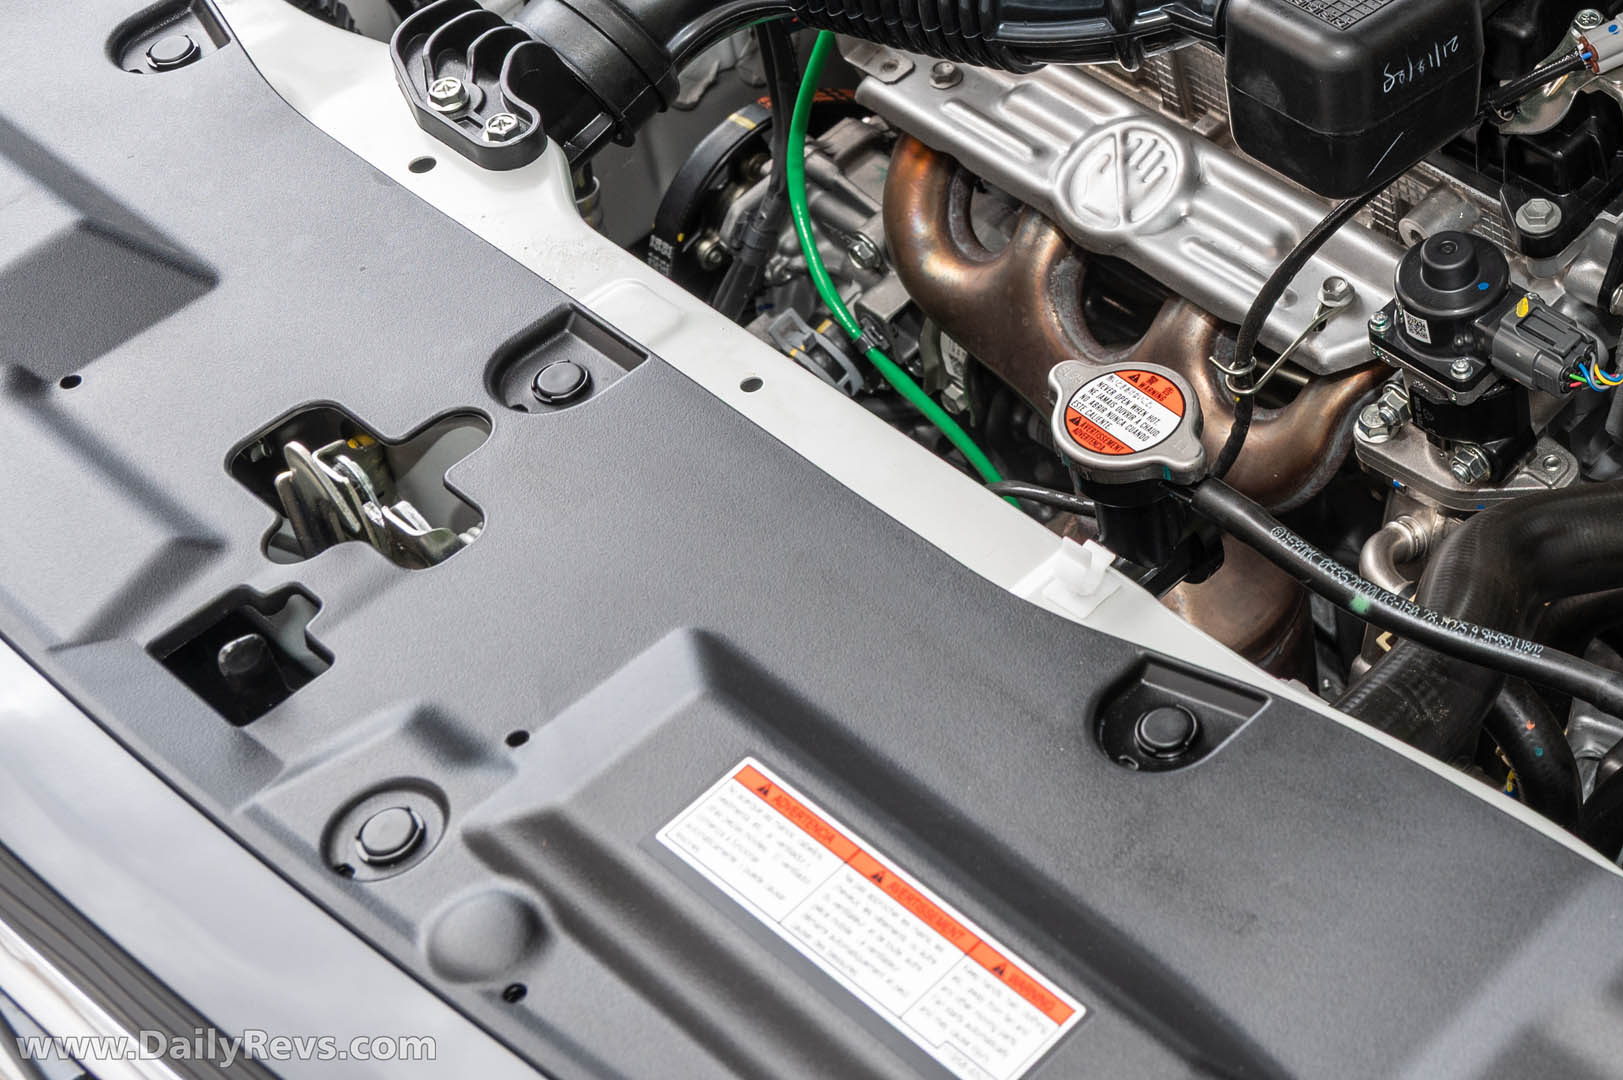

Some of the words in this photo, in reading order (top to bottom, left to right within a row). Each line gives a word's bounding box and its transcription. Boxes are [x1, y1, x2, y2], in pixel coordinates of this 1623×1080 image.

[1070, 400, 1087, 413] ESTE
[1088, 388, 1099, 398] NE
[1097, 394, 1118, 409] JAMAIS
[1115, 405, 1135, 421] OUVRIR
[1098, 381, 1117, 399] NEVER
[1116, 393, 1131, 406] OPEN
[1130, 403, 1147, 418] WHEN
[1079, 393, 1090, 404] NO
[1089, 399, 1107, 414] ABRIR
[1106, 411, 1127, 428] NUNCA
[1125, 424, 1150, 442] CUANDO
[1079, 421, 1125, 453] AVERTISSEMENT
